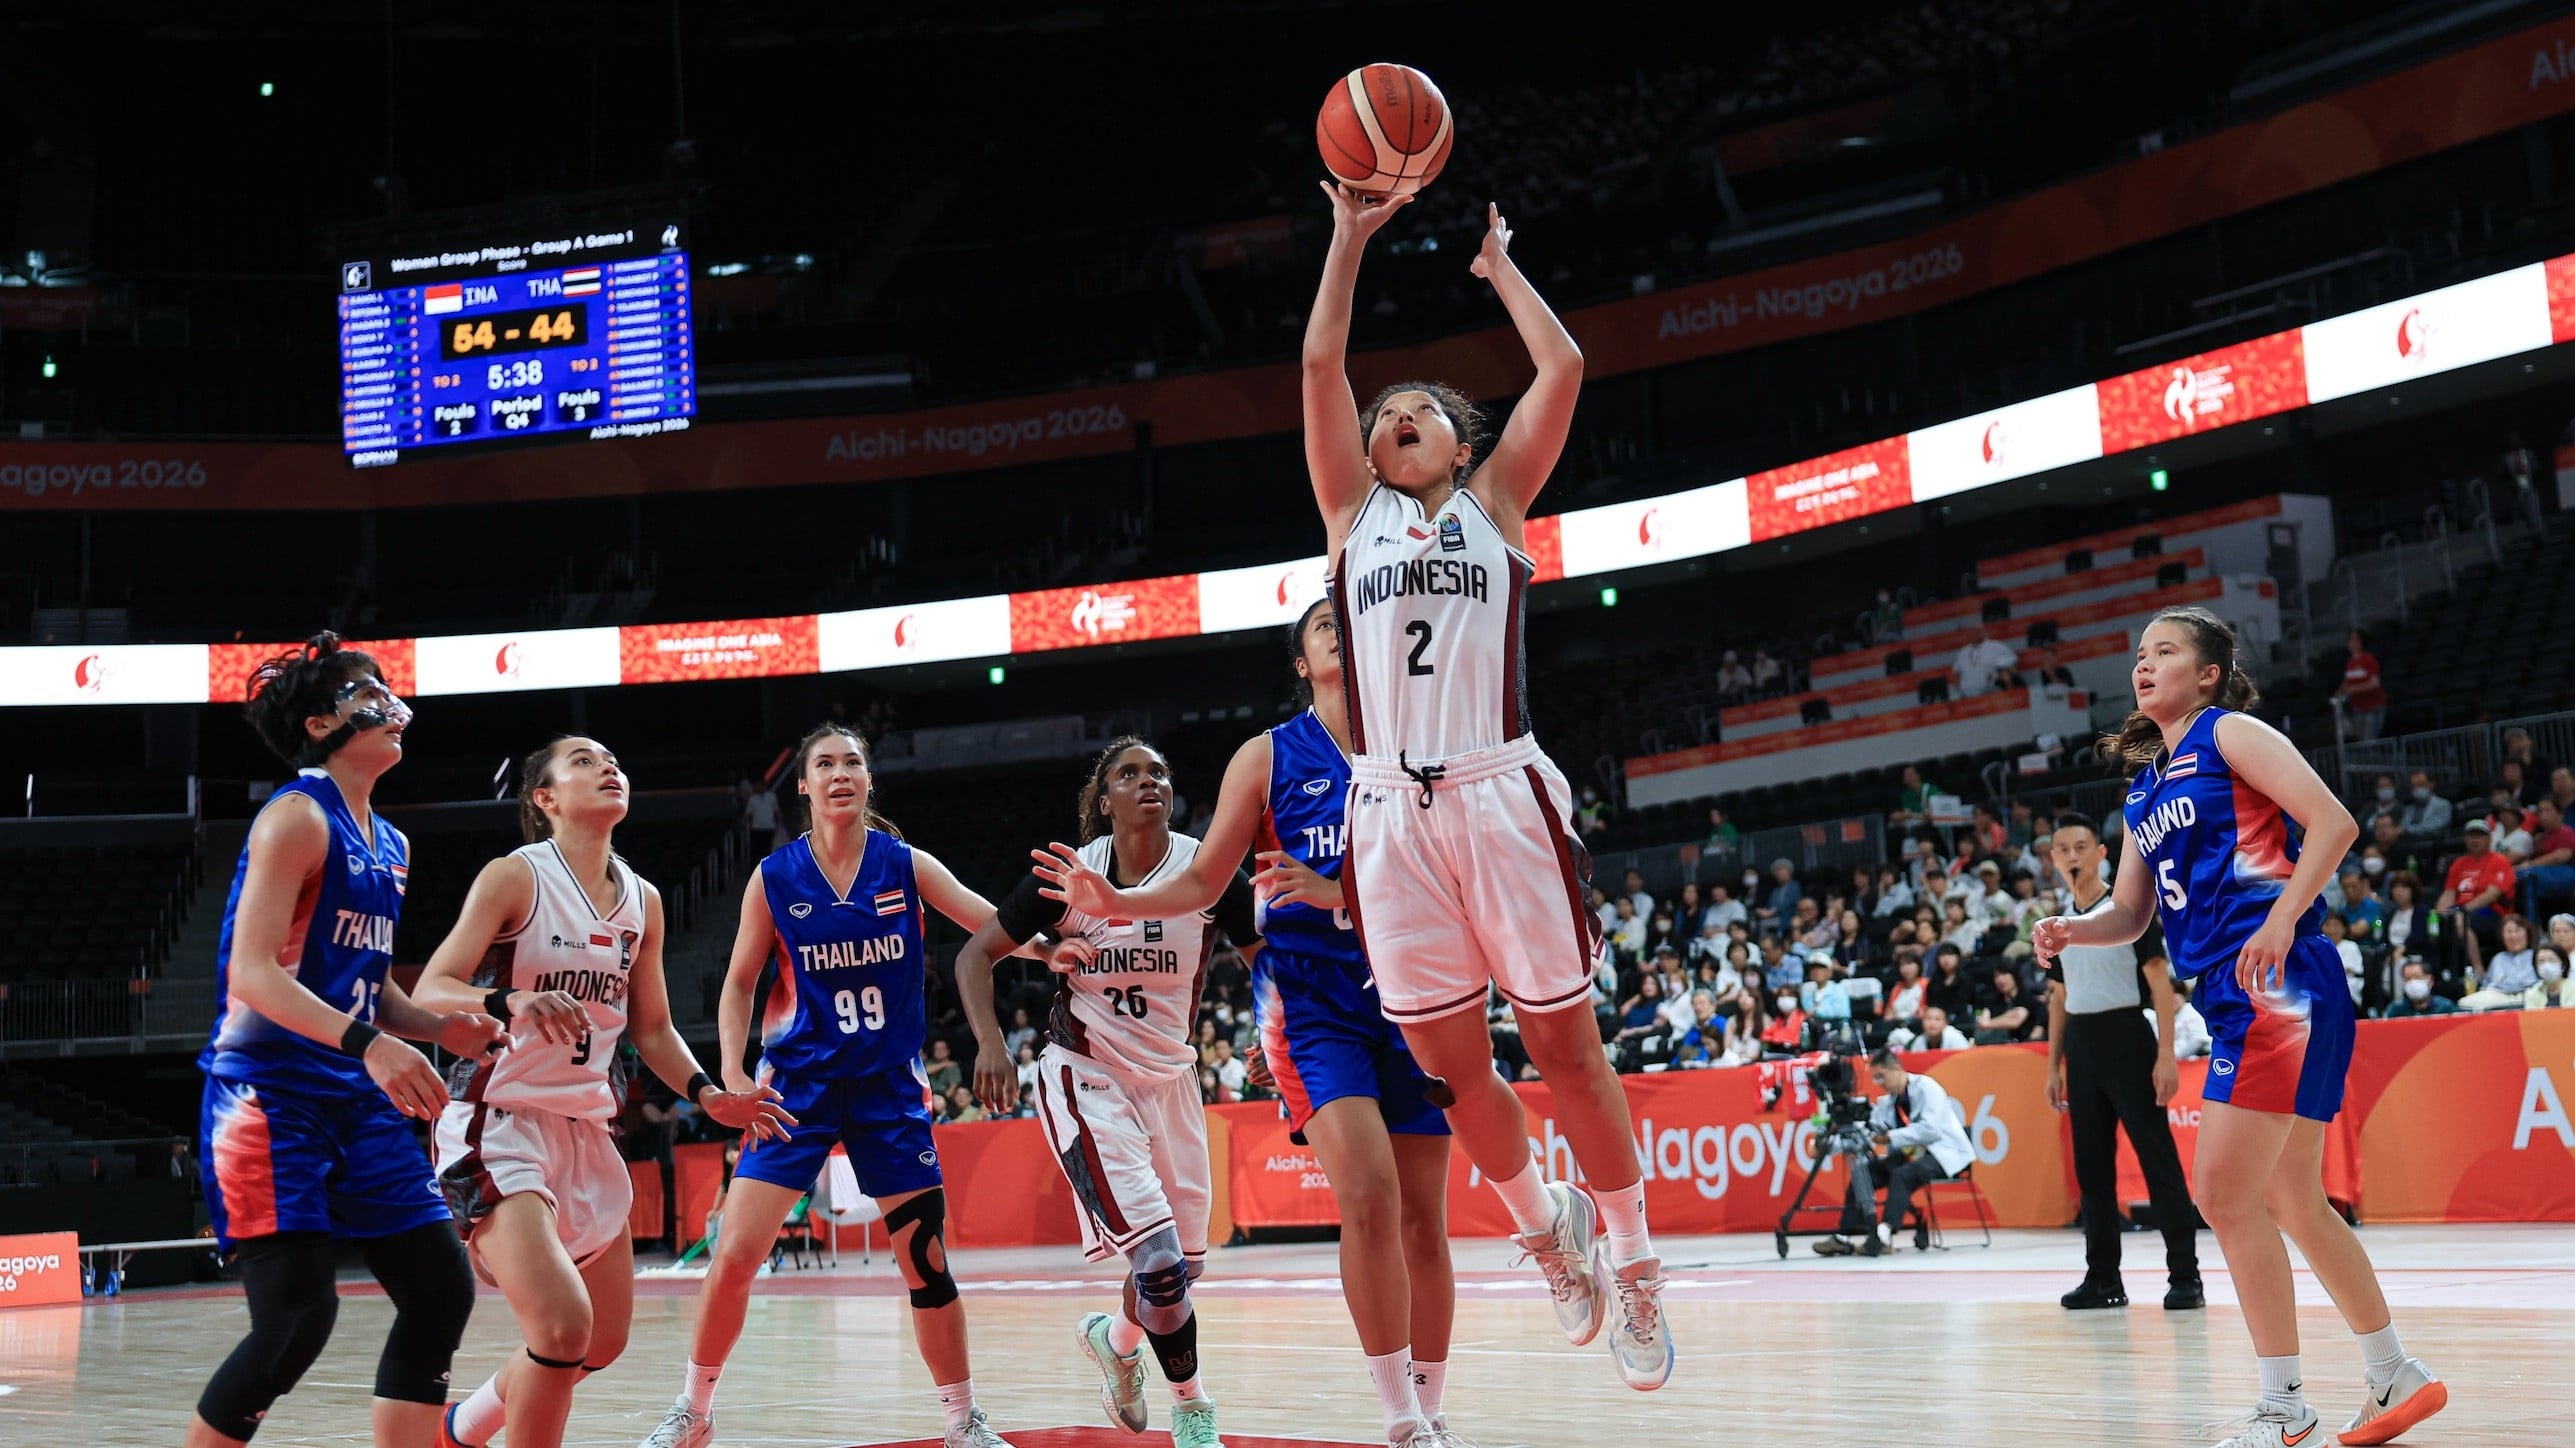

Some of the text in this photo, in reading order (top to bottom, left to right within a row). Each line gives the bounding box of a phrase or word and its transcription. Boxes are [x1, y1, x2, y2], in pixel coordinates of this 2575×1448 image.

[391, 256, 438, 272] Women
[440, 252, 480, 266] Group
[481, 246, 521, 262] Phase
[531, 240, 571, 255] Group
[572, 236, 584, 250] A
[585, 234, 625, 248] Game
[465, 286, 498, 306] INA
[528, 277, 562, 297] THA
[1657, 242, 1964, 341] Aichi-Nagoya 2026
[453, 321, 496, 353] 54
[529, 311, 575, 343] 44
[487, 360, 543, 390] 5:38
[492, 394, 543, 416] Period
[558, 389, 601, 409] Fouls
[434, 403, 476, 422] Fouls
[505, 414, 530, 431] Q4
[573, 407, 586, 422] 3
[450, 420, 462, 436] 2
[825, 403, 1127, 461] Aichi-Nagoya 2026
[0, 459, 208, 496] agoya 2026
[1358, 559, 1487, 616] INDONESIA
[717, 634, 748, 650] ONE
[1405, 620, 1434, 676] 2
[564, 941, 586, 949] MILLS
[798, 934, 904, 972] THAILAND
[834, 986, 885, 1034] 99
[1103, 984, 1148, 1019] 26
[0, 1254, 60, 1276] agoya
